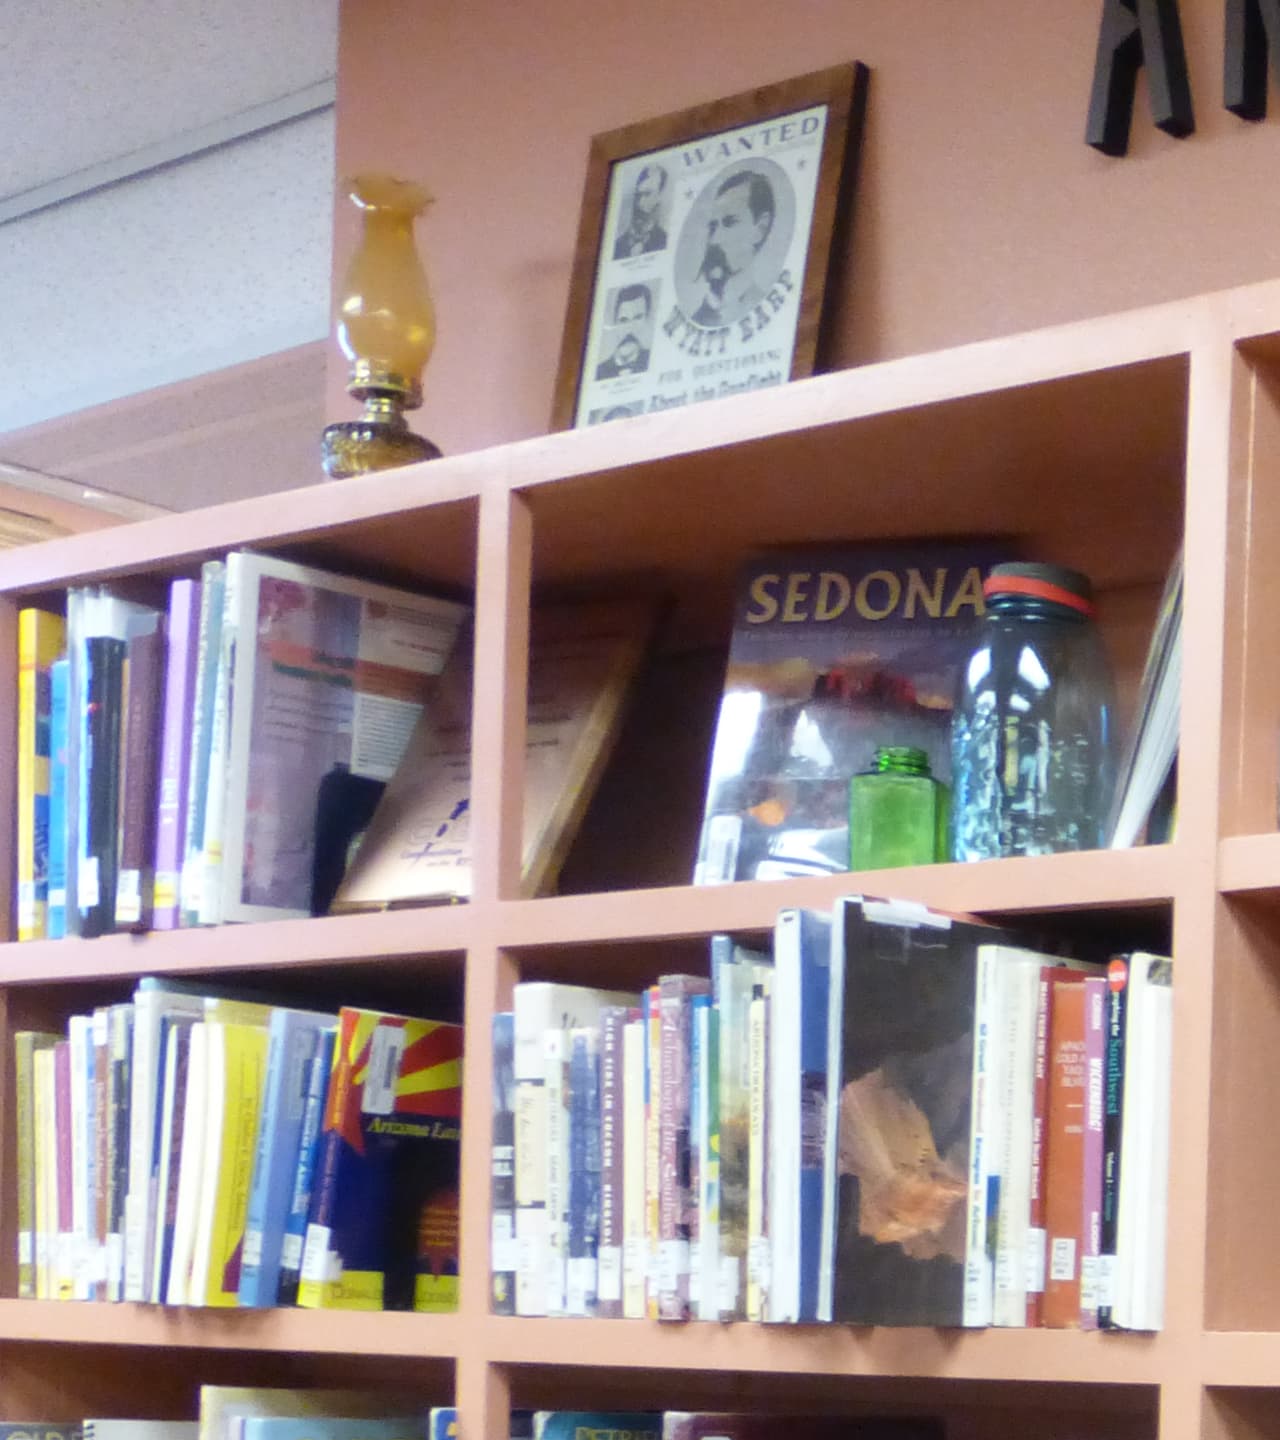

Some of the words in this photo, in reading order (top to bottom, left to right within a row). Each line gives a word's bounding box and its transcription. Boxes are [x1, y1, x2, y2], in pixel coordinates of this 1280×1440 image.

[683, 116, 819, 166] WANTED
[662, 304, 730, 356] WYATT
[738, 269, 793, 342] EARP
[658, 368, 684, 385] FOR
[693, 348, 781, 380] QUESTIONING
[745, 567, 986, 624] SEDONA
[1088, 1057, 1103, 1132] WICKENBURG!
[1107, 1039, 1123, 1115] Southwest
[368, 1117, 430, 1137] Arizona
